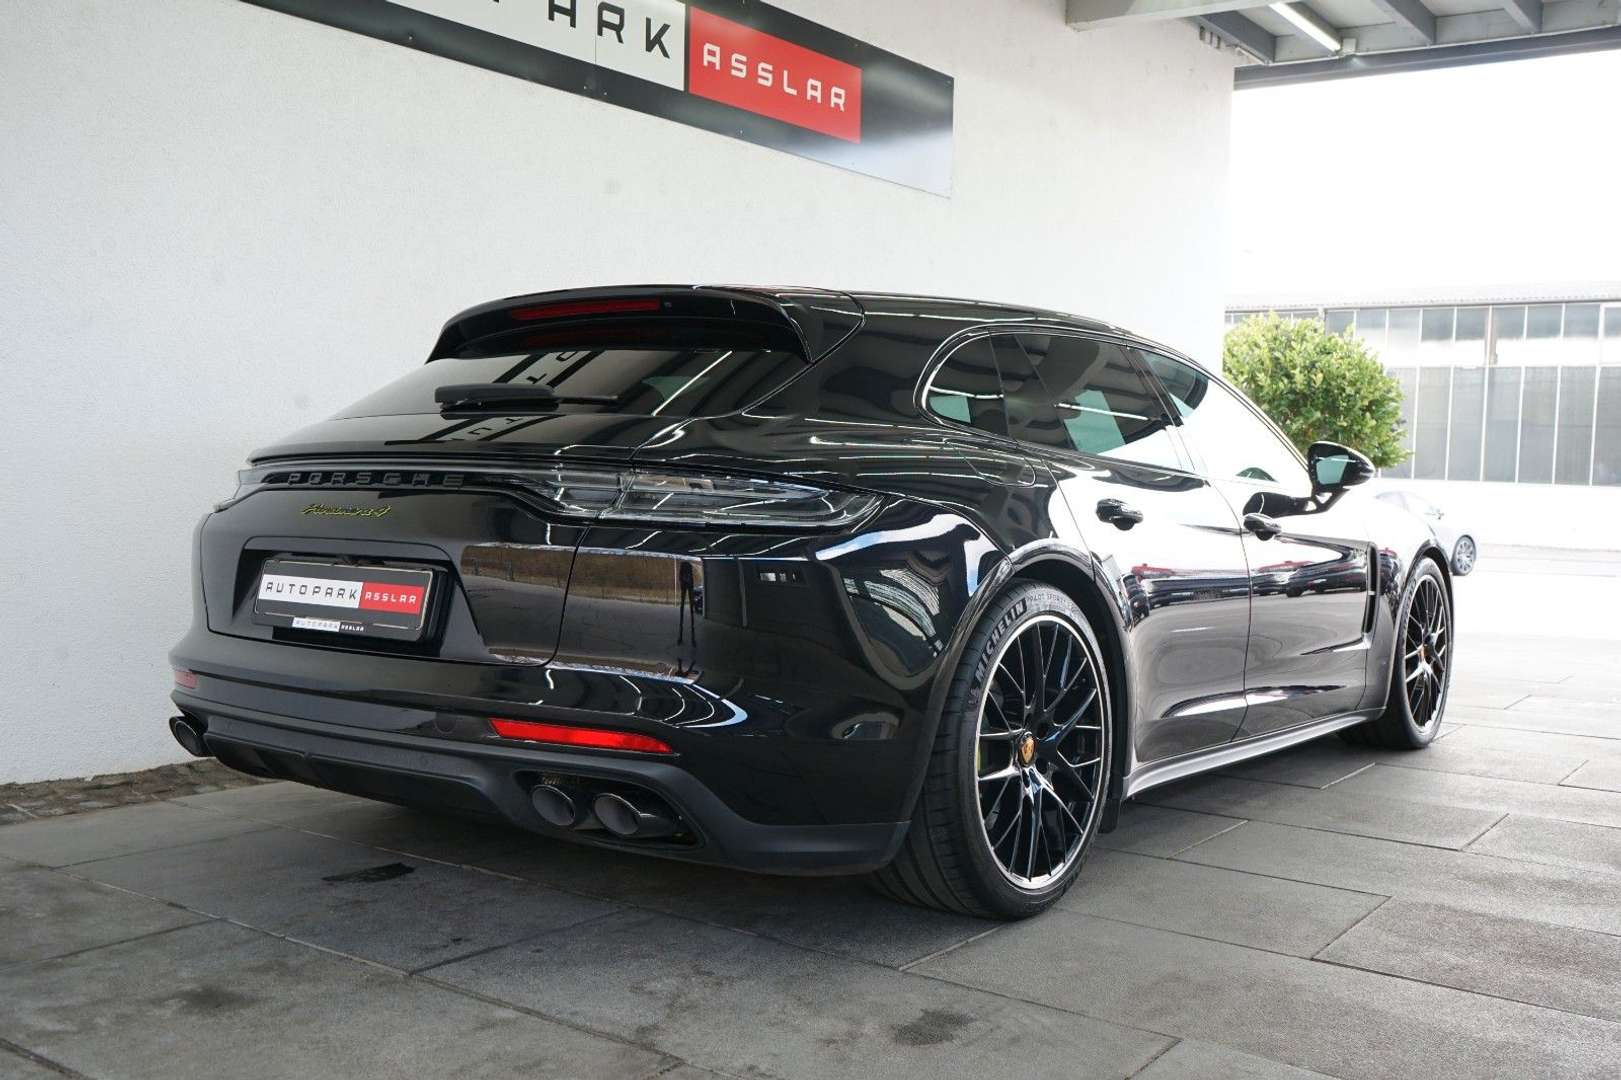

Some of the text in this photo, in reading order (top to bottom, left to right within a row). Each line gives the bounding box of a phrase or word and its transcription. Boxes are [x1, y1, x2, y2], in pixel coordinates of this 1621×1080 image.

[493, 0, 846, 111] ARK ASSLAR
[287, 471, 465, 488] PORSCHE
[265, 581, 417, 605] AUTOPARK ASSLAR
[975, 602, 1025, 683] MICHELIN
